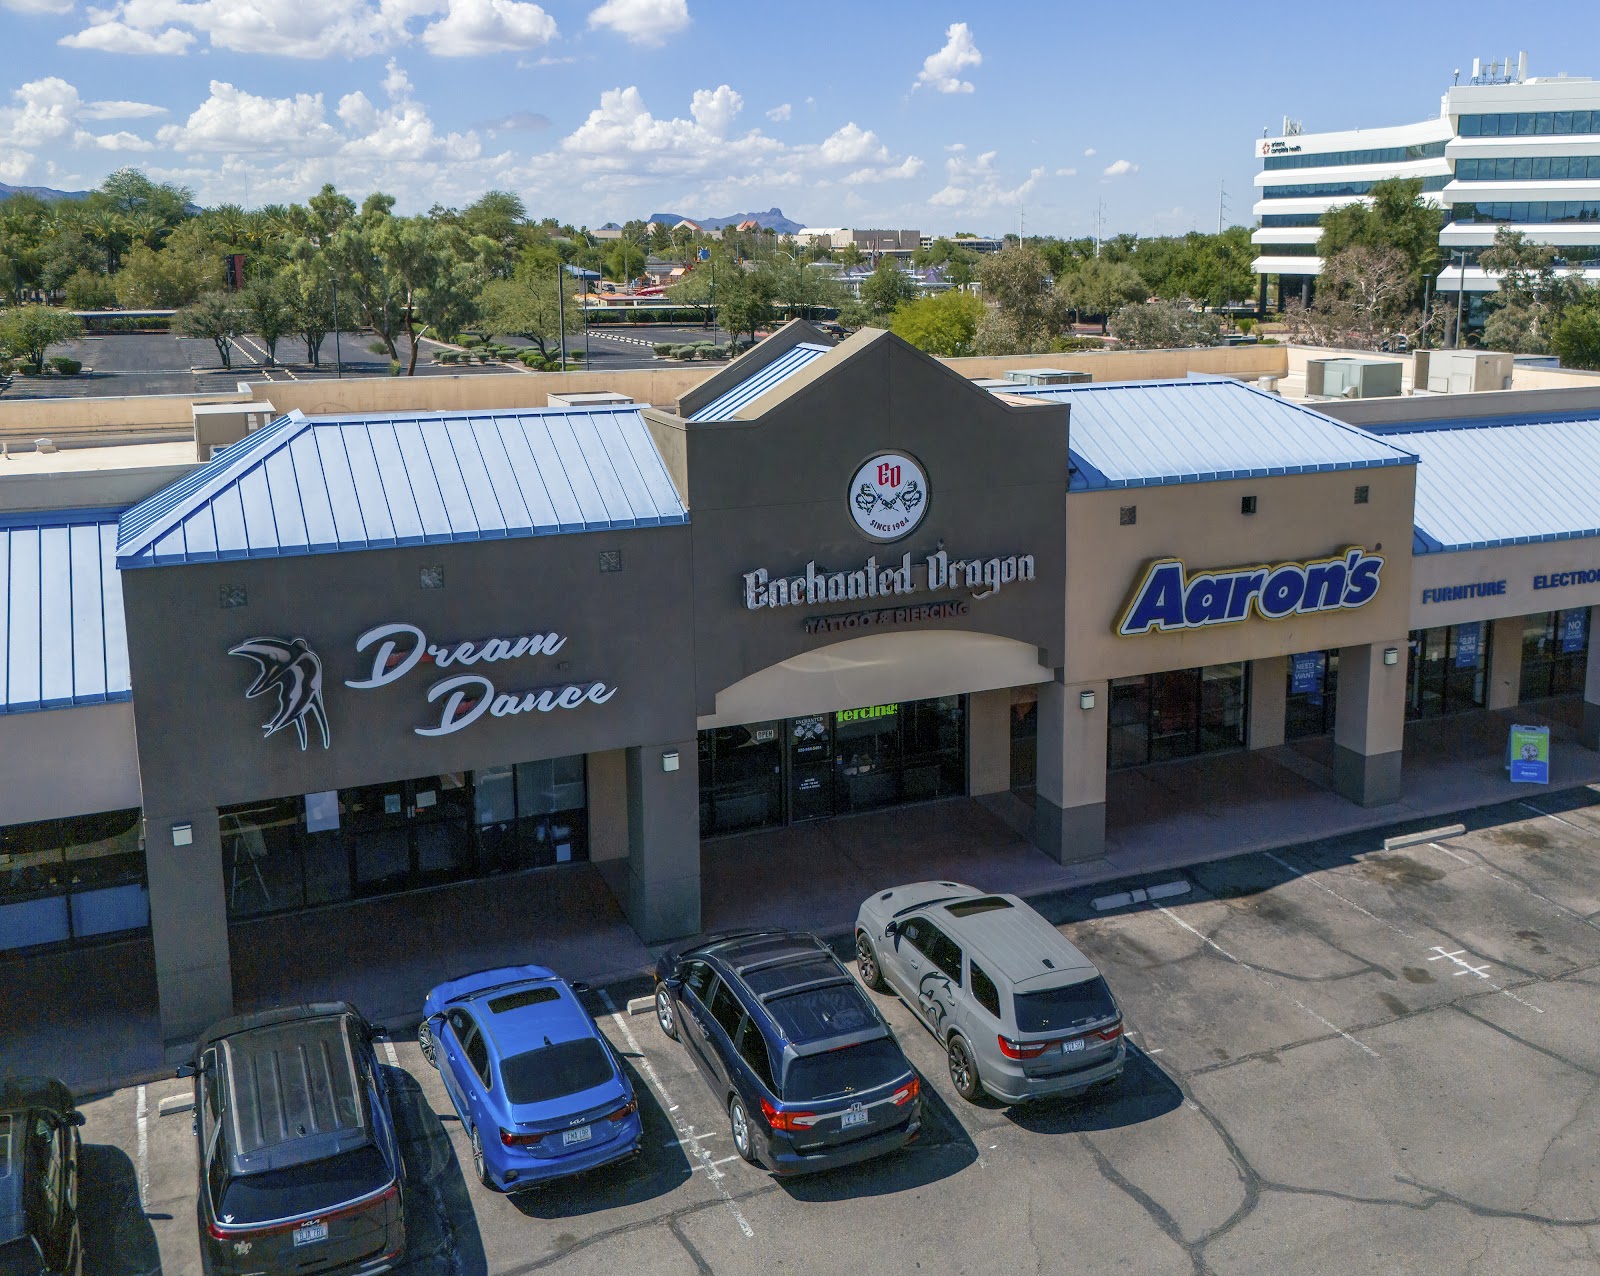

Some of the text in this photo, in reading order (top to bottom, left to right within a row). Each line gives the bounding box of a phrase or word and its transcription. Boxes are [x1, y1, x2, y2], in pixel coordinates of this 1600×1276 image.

[870, 517, 909, 532] SINCE 1984
[743, 550, 1036, 610] Enchanted Dragon
[1118, 547, 1386, 636] Aaron's
[1422, 580, 1507, 604] FURNITURE
[805, 602, 970, 635] TATTOO & PIERCING
[1568, 620, 1582, 630] NO
[344, 622, 568, 689] Dream
[1460, 644, 1476, 652] NOW
[1294, 671, 1315, 680] WANT
[1296, 662, 1315, 670] NEED
[414, 674, 618, 737] Dance
[757, 730, 774, 740] OPEN
